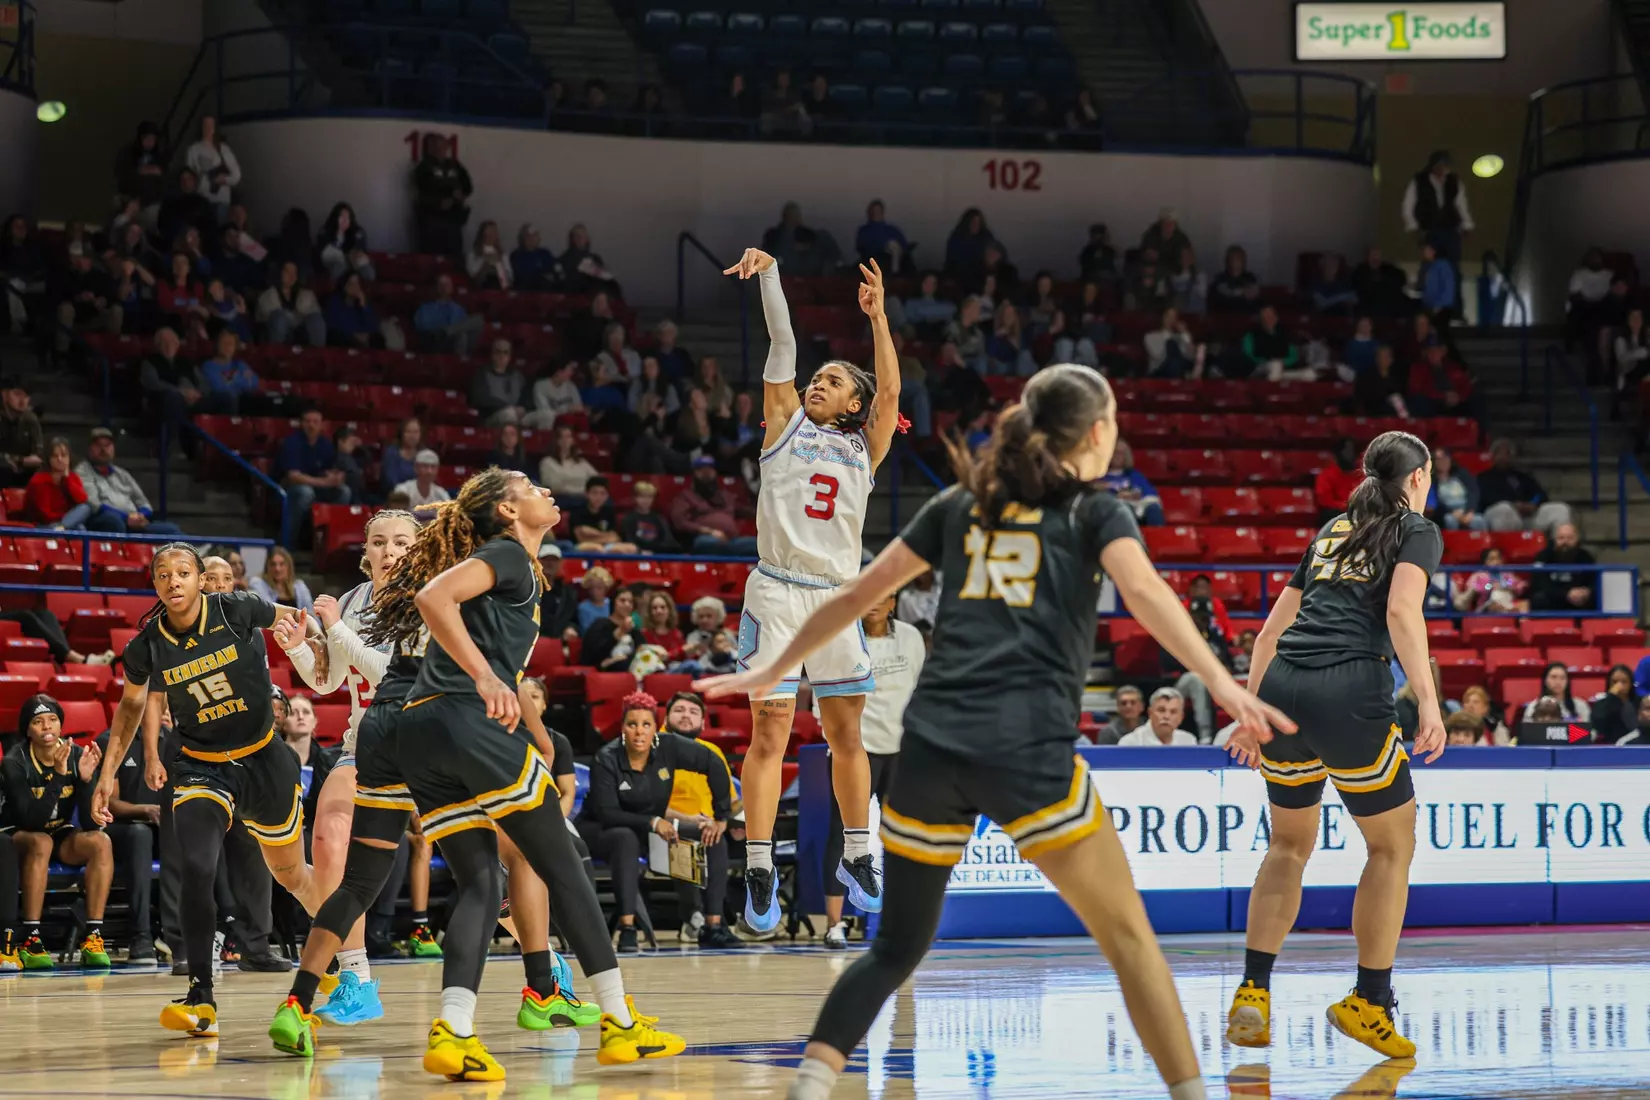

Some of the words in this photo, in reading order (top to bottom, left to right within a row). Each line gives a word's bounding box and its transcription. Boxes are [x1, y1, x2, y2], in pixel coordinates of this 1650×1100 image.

[1307, 16, 1384, 47] Super
[1386, 10, 1410, 51] 1
[1412, 14, 1491, 39] Foods
[404, 129, 458, 163] 11
[981, 158, 1042, 192] 102
[804, 473, 839, 520] 3
[959, 524, 1042, 607] 12
[161, 643, 240, 686] KENNESAW
[186, 671, 234, 708] 15
[196, 697, 249, 724] STATE
[1105, 804, 1346, 853] PROPAE
[1415, 802, 1517, 850] UEL
[1535, 802, 1625, 848] FOR
[975, 869, 1043, 883] DEALERS
